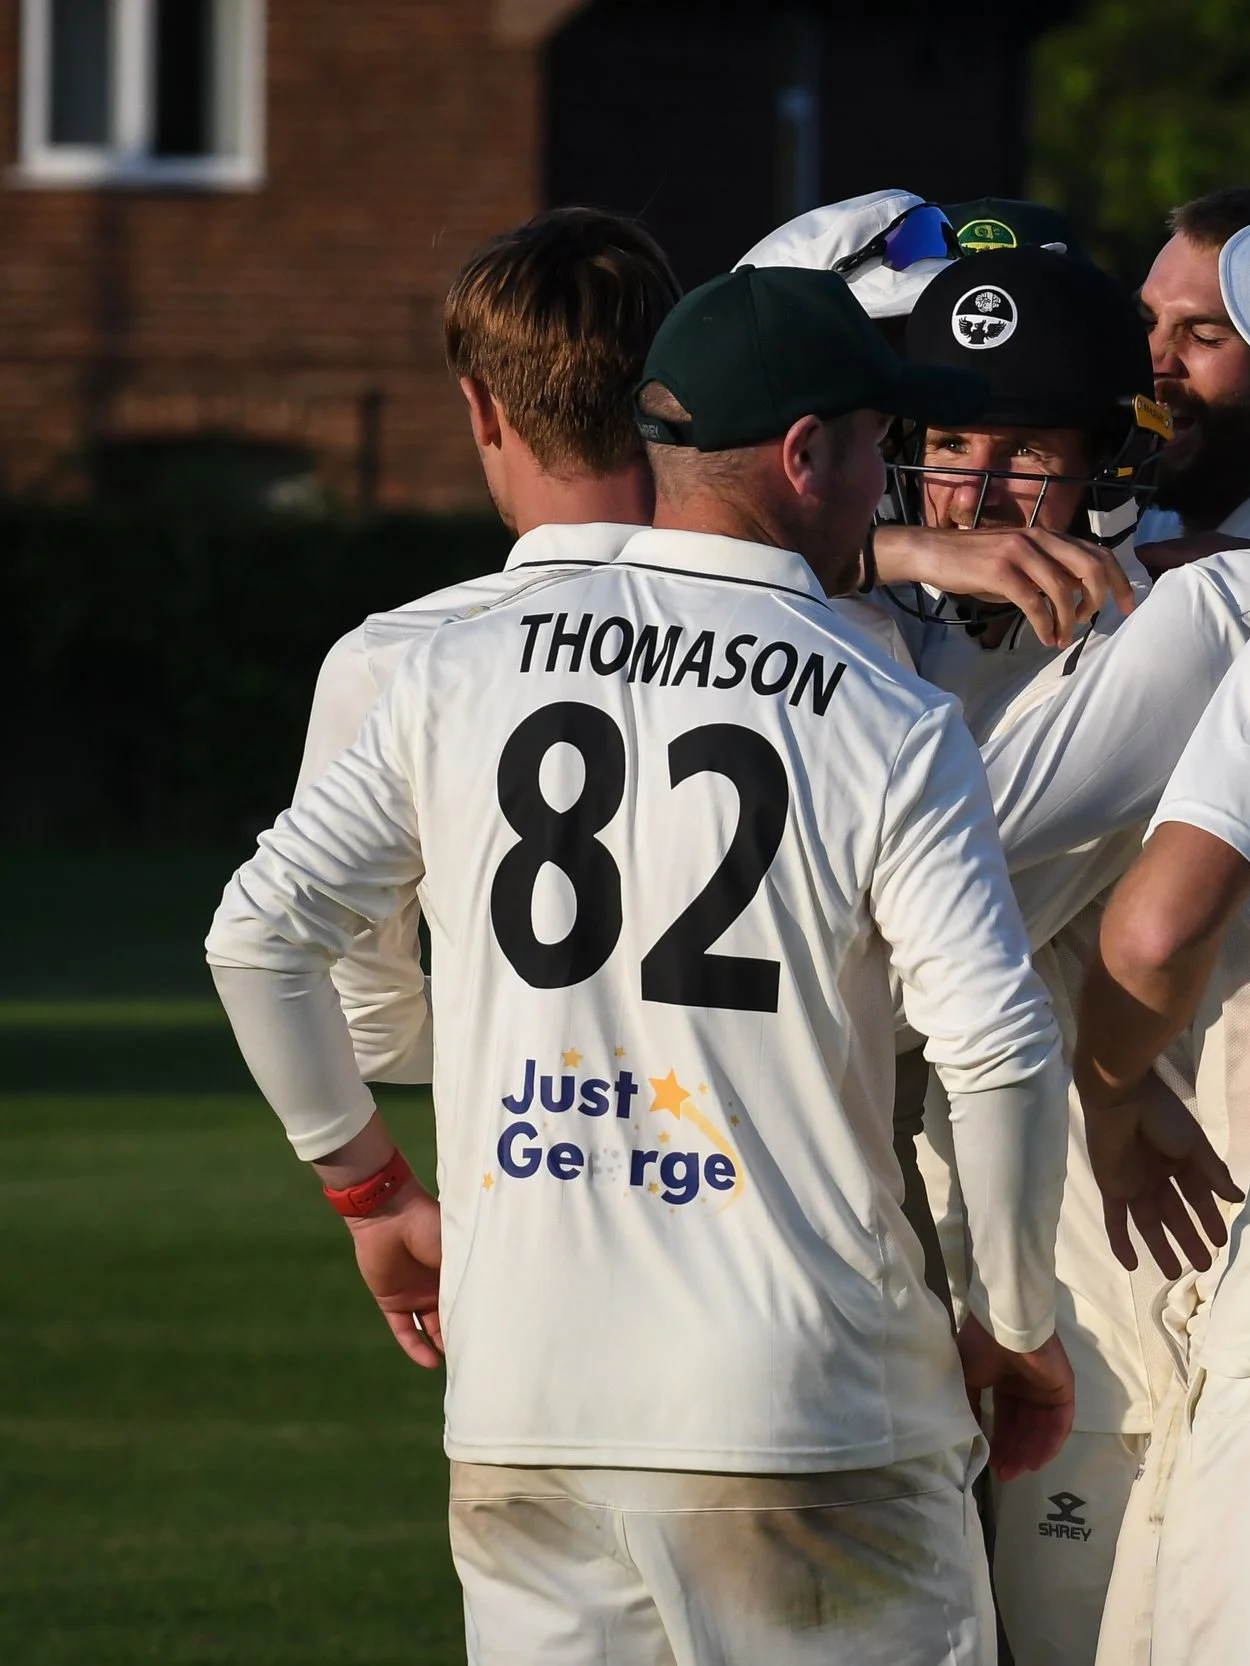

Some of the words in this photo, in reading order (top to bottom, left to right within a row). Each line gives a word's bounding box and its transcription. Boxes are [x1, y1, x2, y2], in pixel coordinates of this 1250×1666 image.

[518, 612, 848, 717] THOMASON
[490, 700, 790, 1013] 82
[502, 1059, 638, 1119] Just
[1038, 1522, 1092, 1542] SHREY
